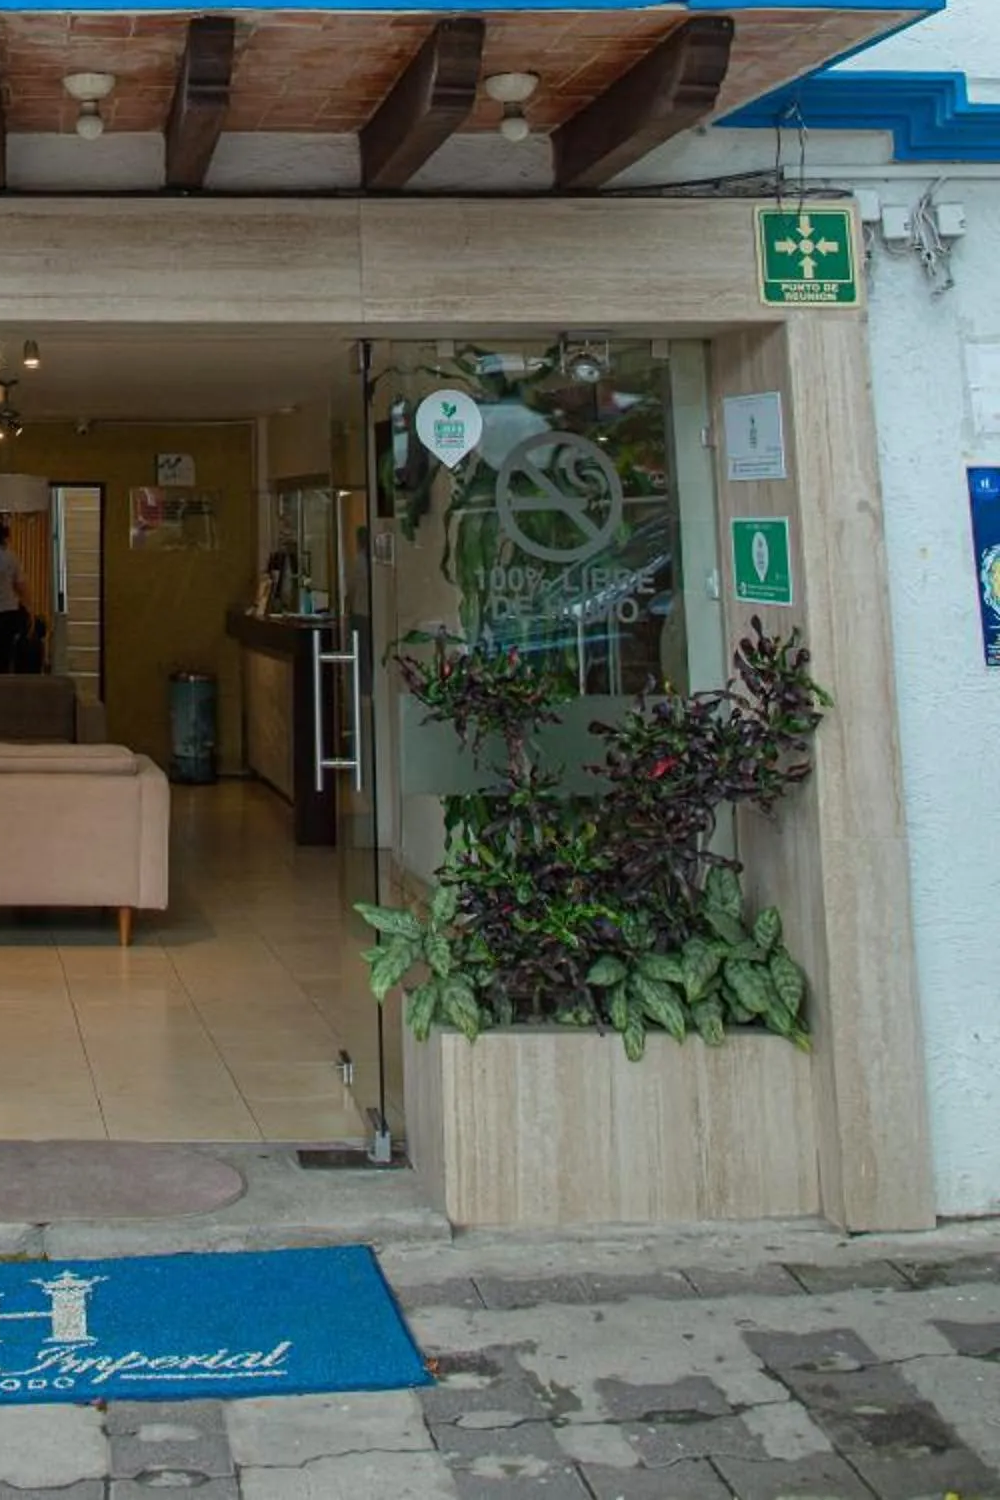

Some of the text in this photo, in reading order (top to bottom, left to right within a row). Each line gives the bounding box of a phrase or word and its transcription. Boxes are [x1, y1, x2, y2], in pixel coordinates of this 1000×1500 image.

[781, 283, 840, 293] PUNTO DE
[474, 566, 551, 592] 100%
